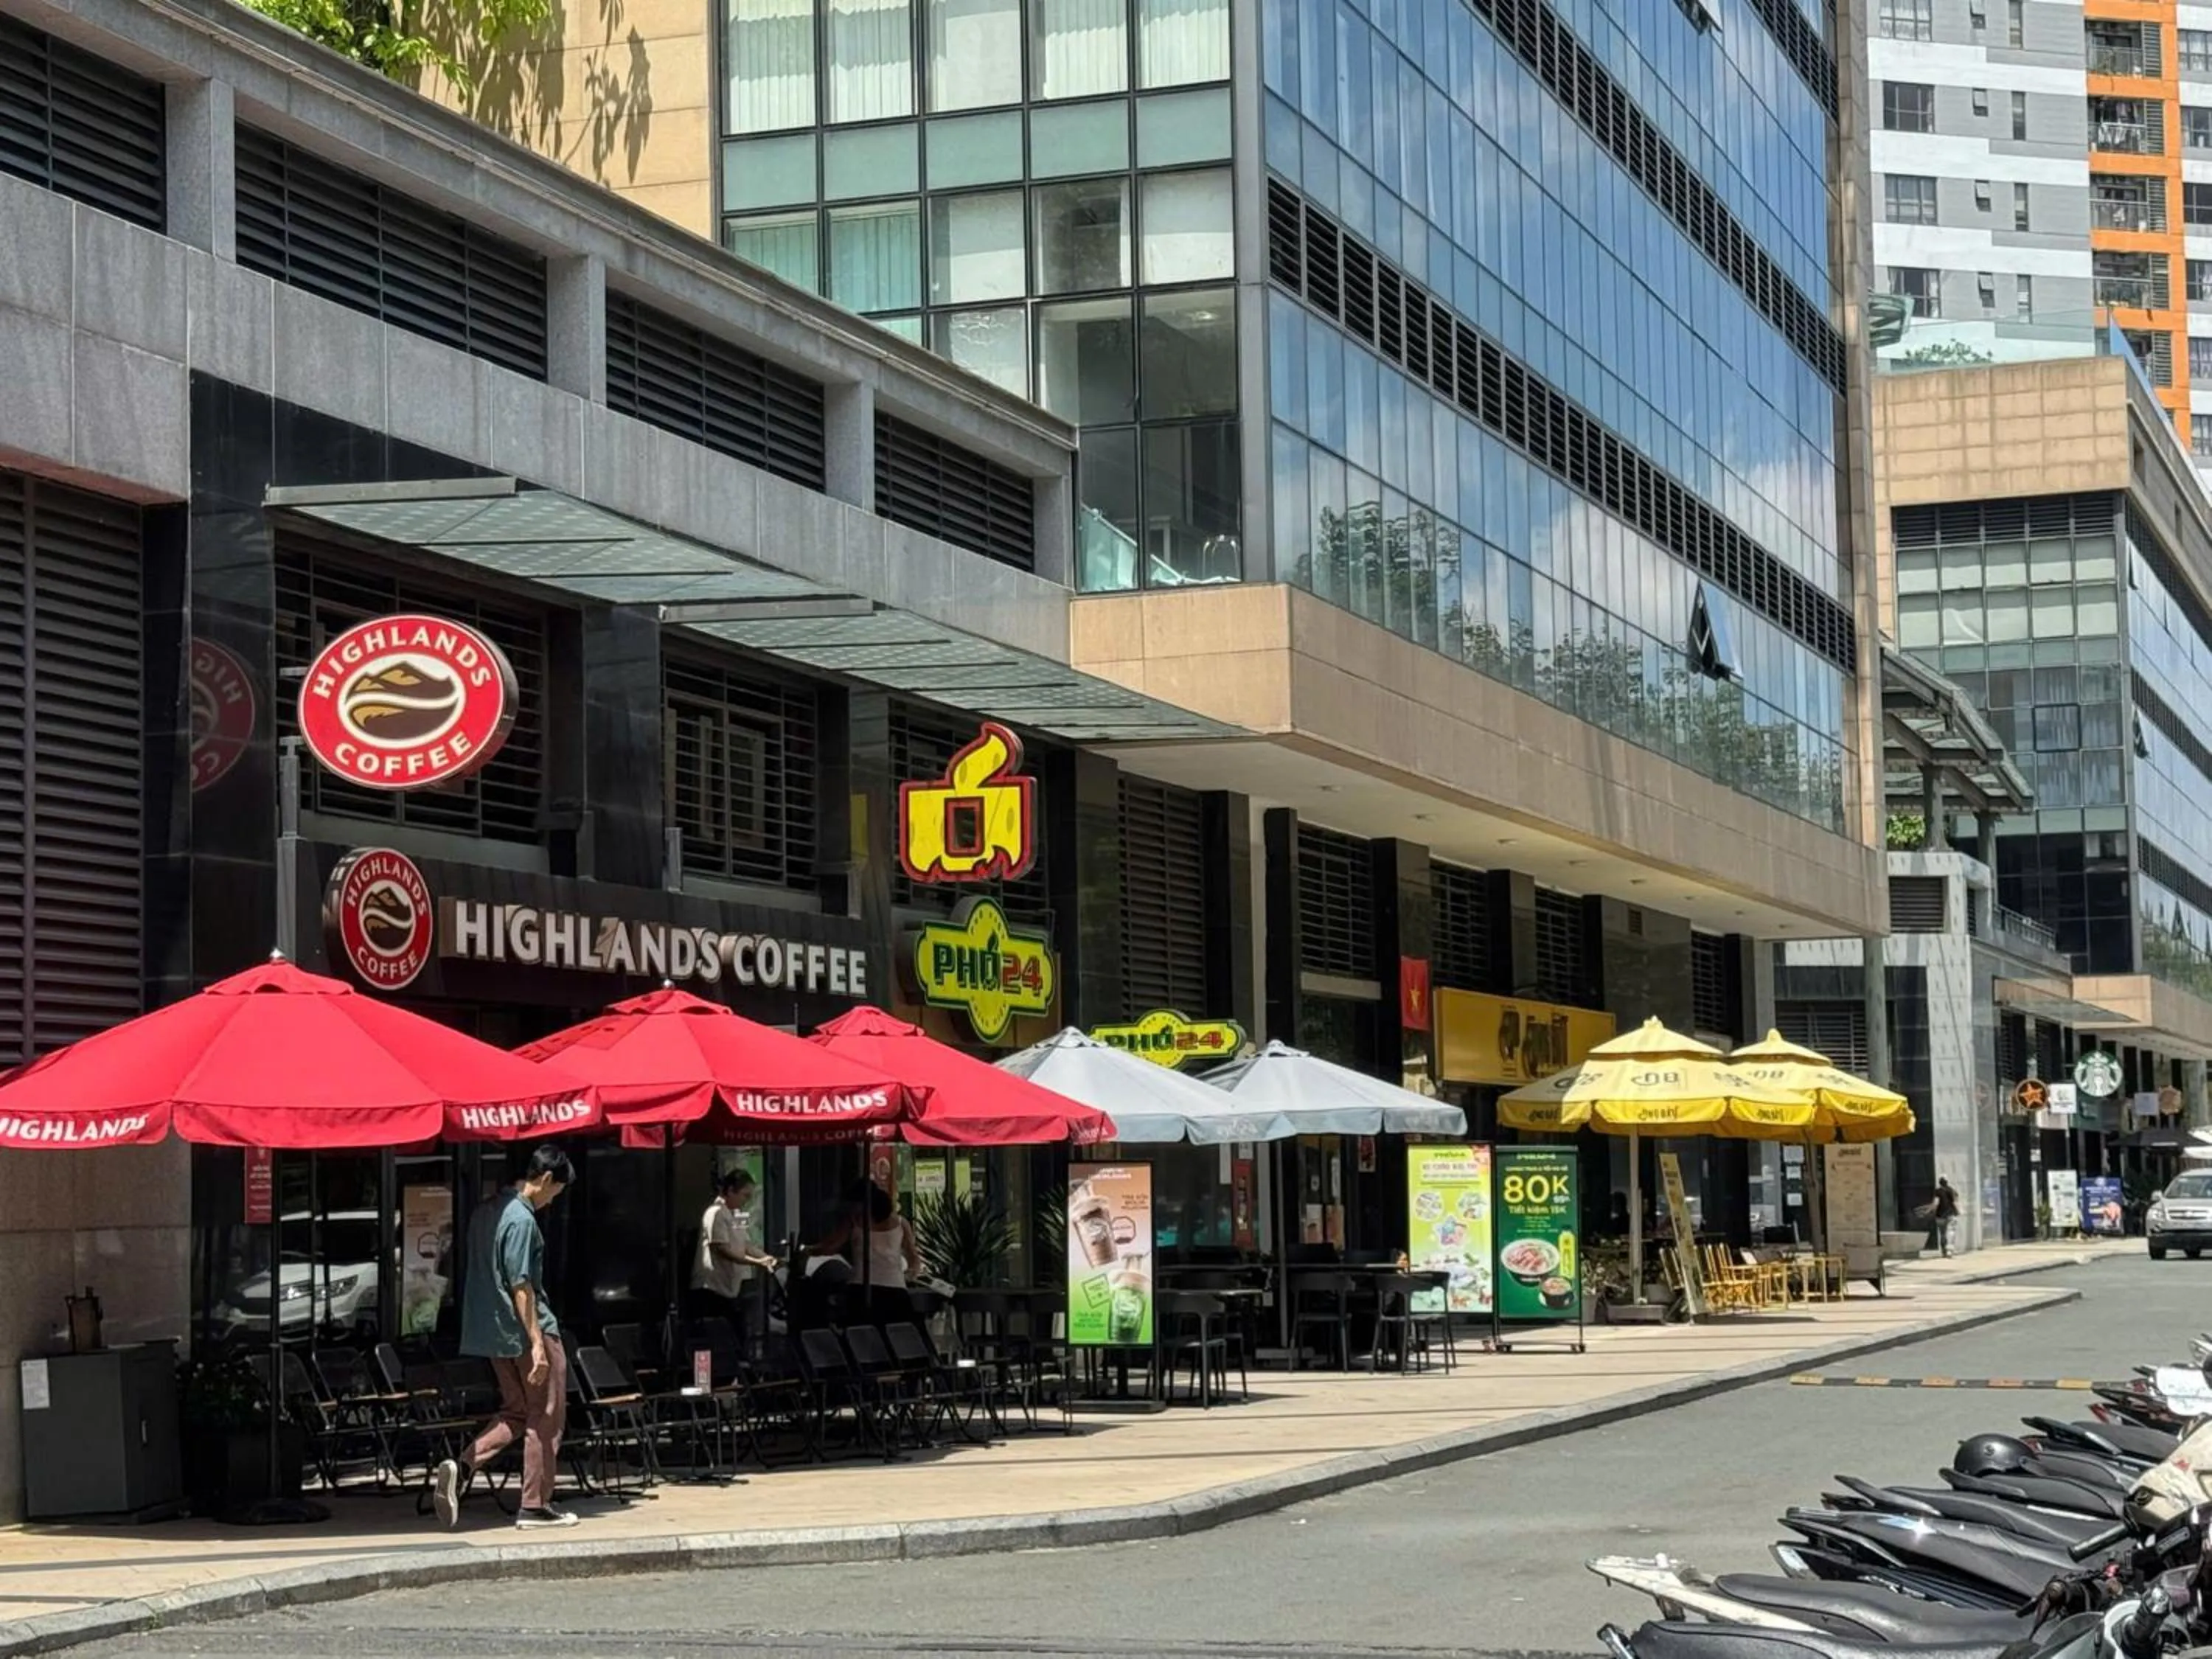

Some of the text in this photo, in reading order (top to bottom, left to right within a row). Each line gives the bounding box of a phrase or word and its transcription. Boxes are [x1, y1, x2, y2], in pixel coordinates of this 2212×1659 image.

[313, 626, 492, 699] HIGHLANDS
[334, 731, 473, 777] COFFEE
[346, 858, 428, 917] HIGHLANDS
[357, 945, 418, 980] COFFEE
[455, 900, 867, 997] HIGHLANDS COFFEE
[461, 1099, 591, 1131] HIGHLANDS
[737, 1090, 888, 1115] HIGHLANDS
[1503, 1175, 1569, 1204] 80K
